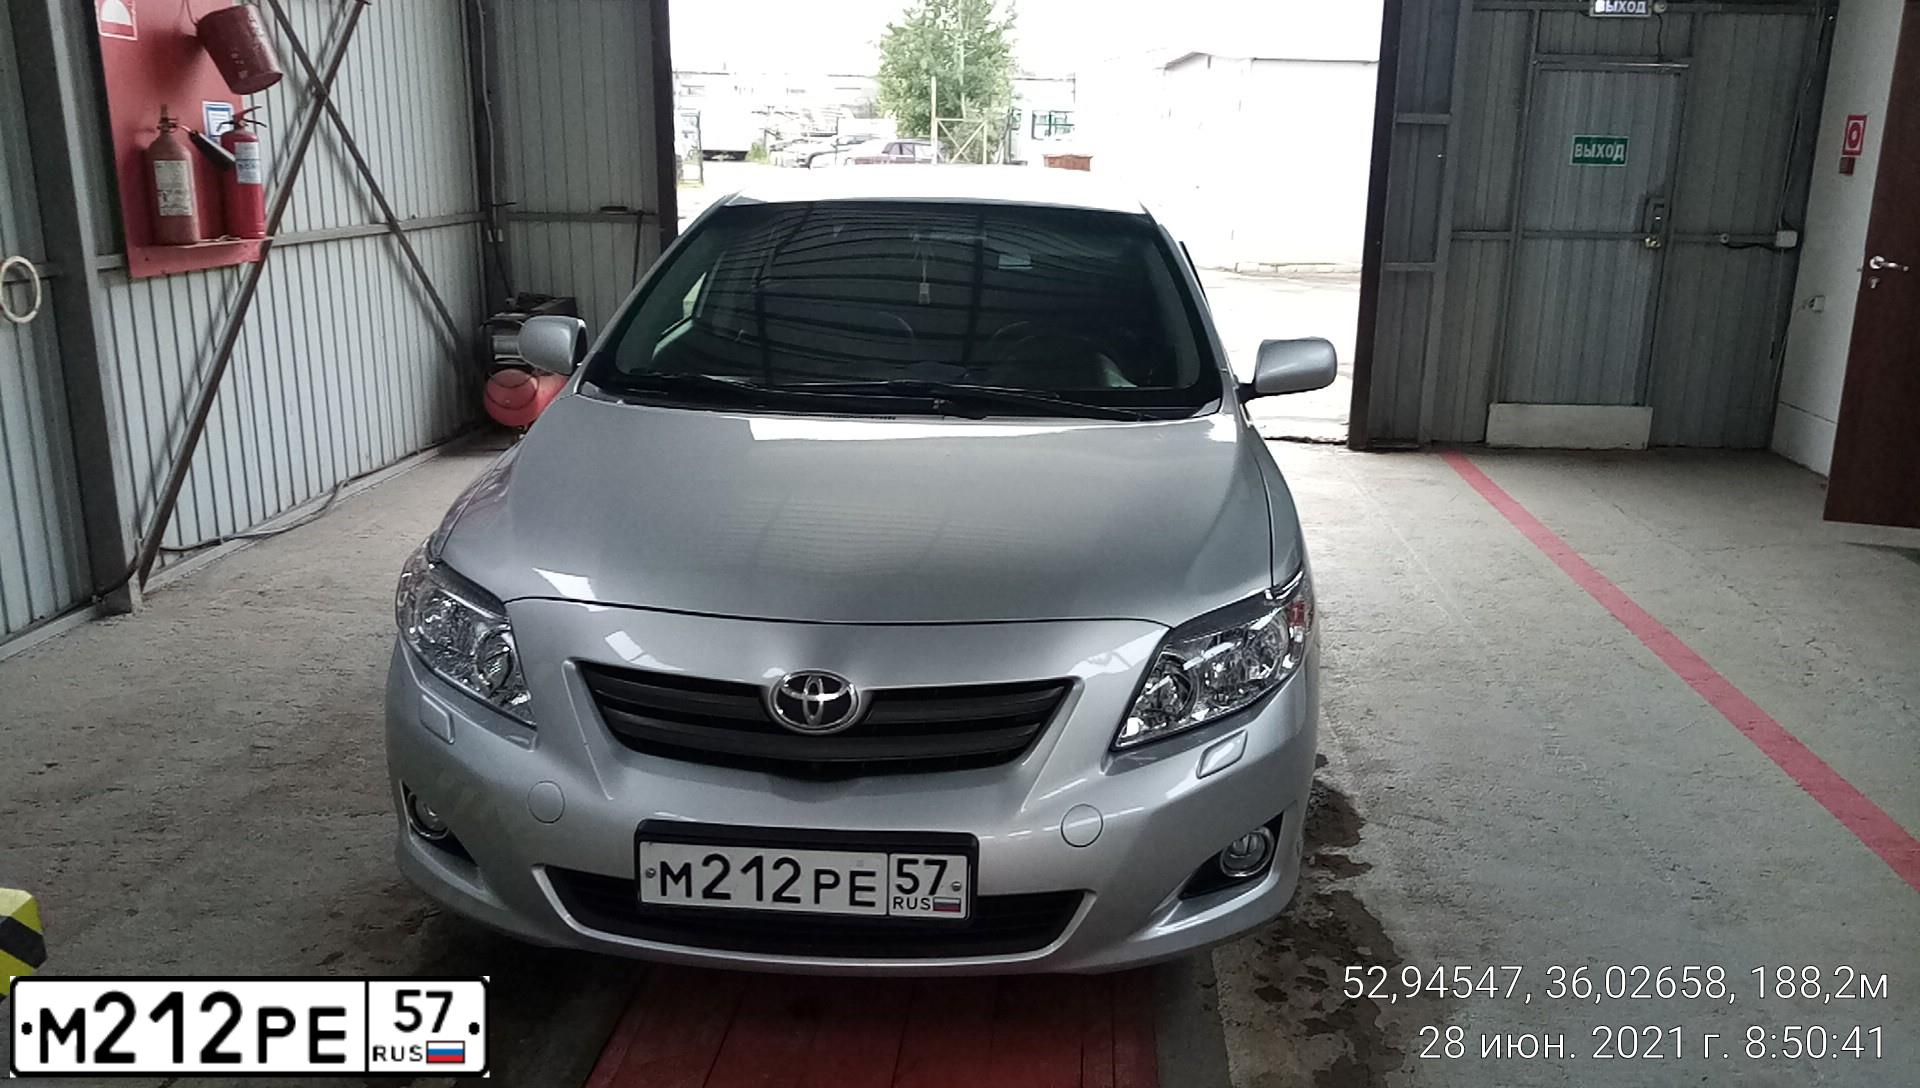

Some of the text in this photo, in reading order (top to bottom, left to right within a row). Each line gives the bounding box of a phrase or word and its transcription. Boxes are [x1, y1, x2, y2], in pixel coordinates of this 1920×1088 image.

[1574, 143, 1625, 161] ВЫХОД
[895, 858, 948, 896] 57
[893, 896, 931, 911] RUS
